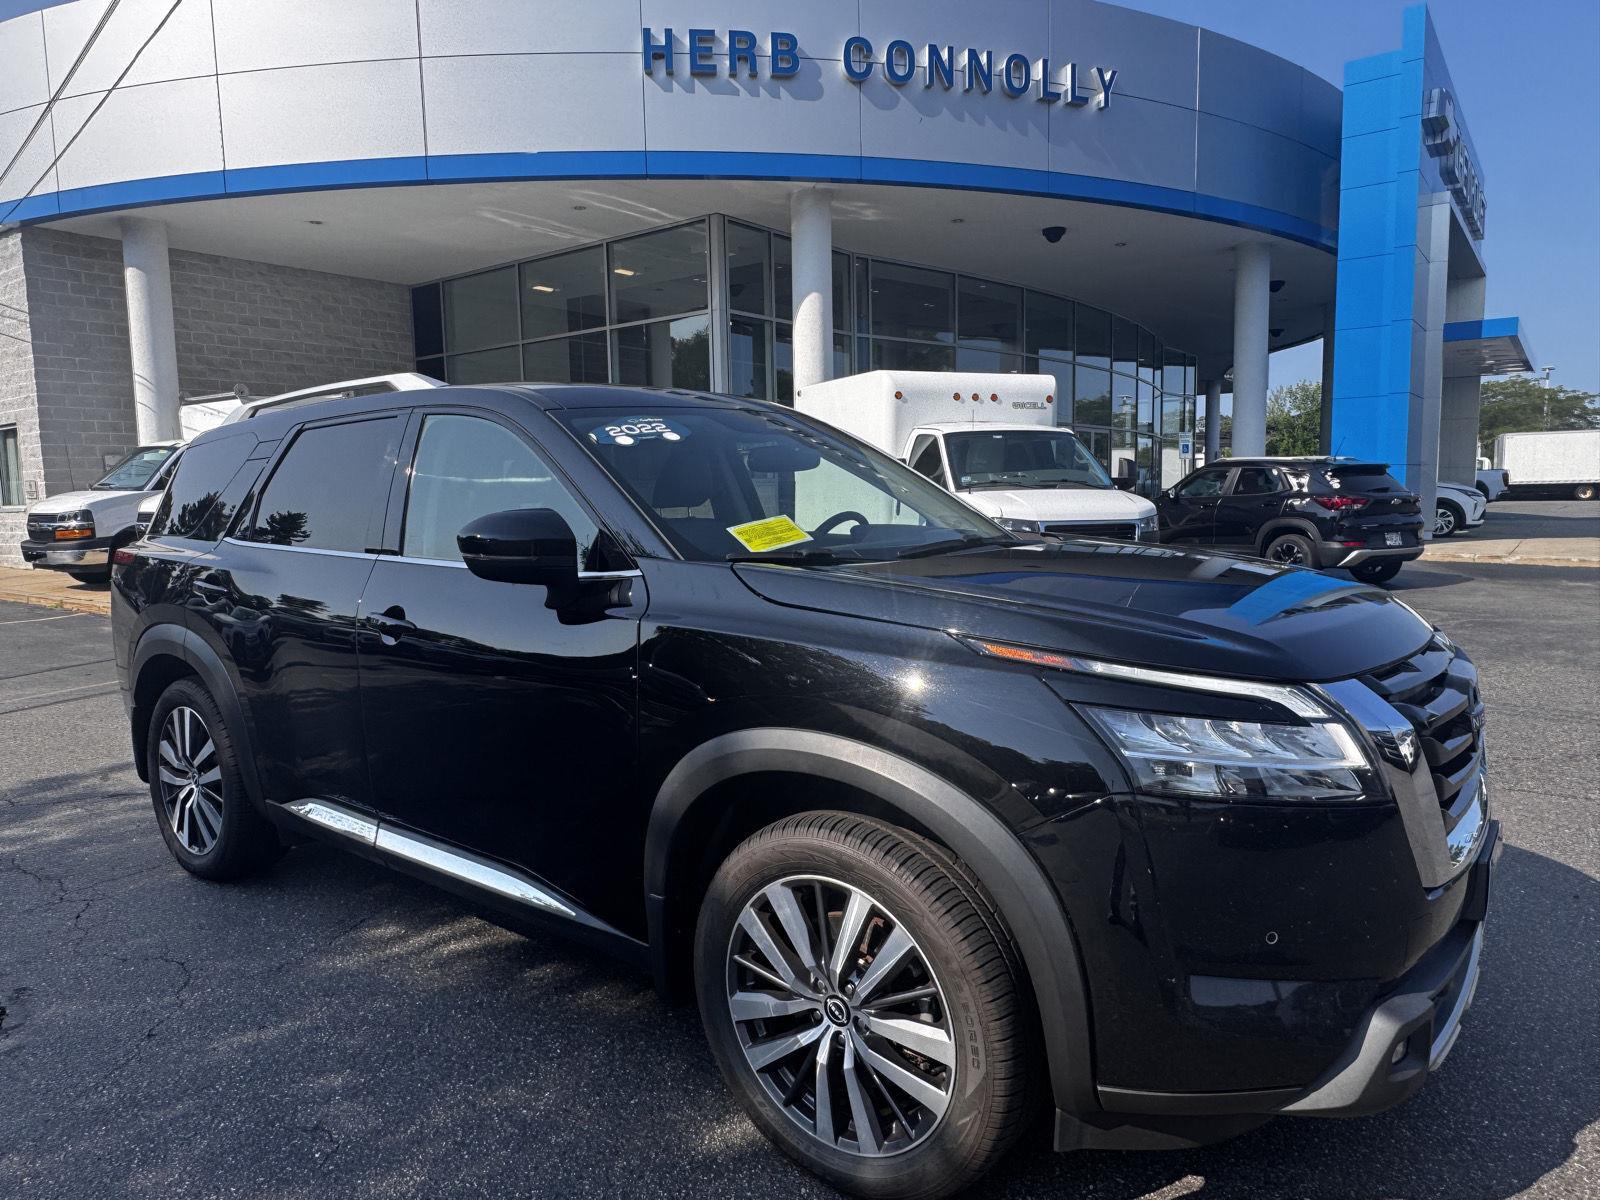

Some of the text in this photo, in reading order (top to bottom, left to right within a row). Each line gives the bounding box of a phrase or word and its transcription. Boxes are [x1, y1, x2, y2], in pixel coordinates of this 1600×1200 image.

[642, 27, 1119, 110] HERB CONNOLLY
[605, 423, 671, 437] 2022
